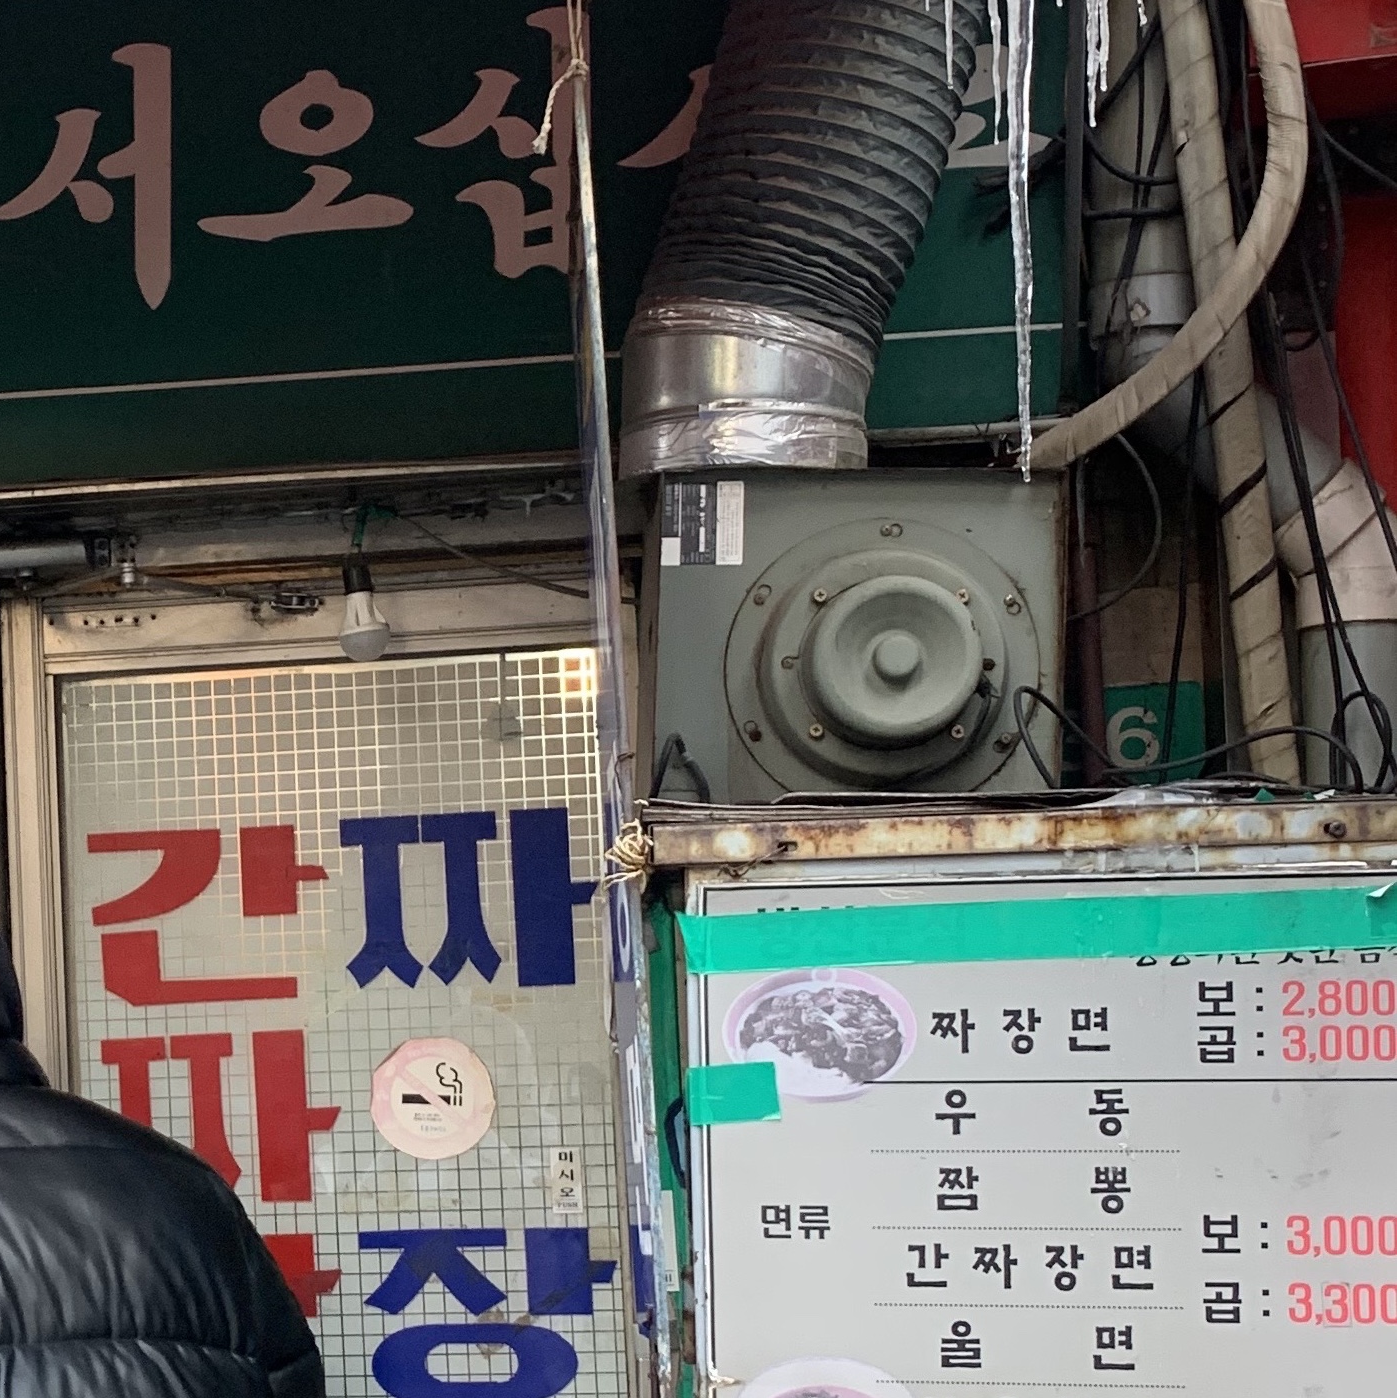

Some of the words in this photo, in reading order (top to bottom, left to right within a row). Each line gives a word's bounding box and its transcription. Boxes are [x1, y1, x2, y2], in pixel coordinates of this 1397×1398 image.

[1106, 706, 1160, 770] 6
[1282, 979, 1396, 1018] 2,800
[1282, 1023, 1397, 1064] 3,000
[557, 1150, 576, 1198] 미시오
[760, 1204, 832, 1241] 면류
